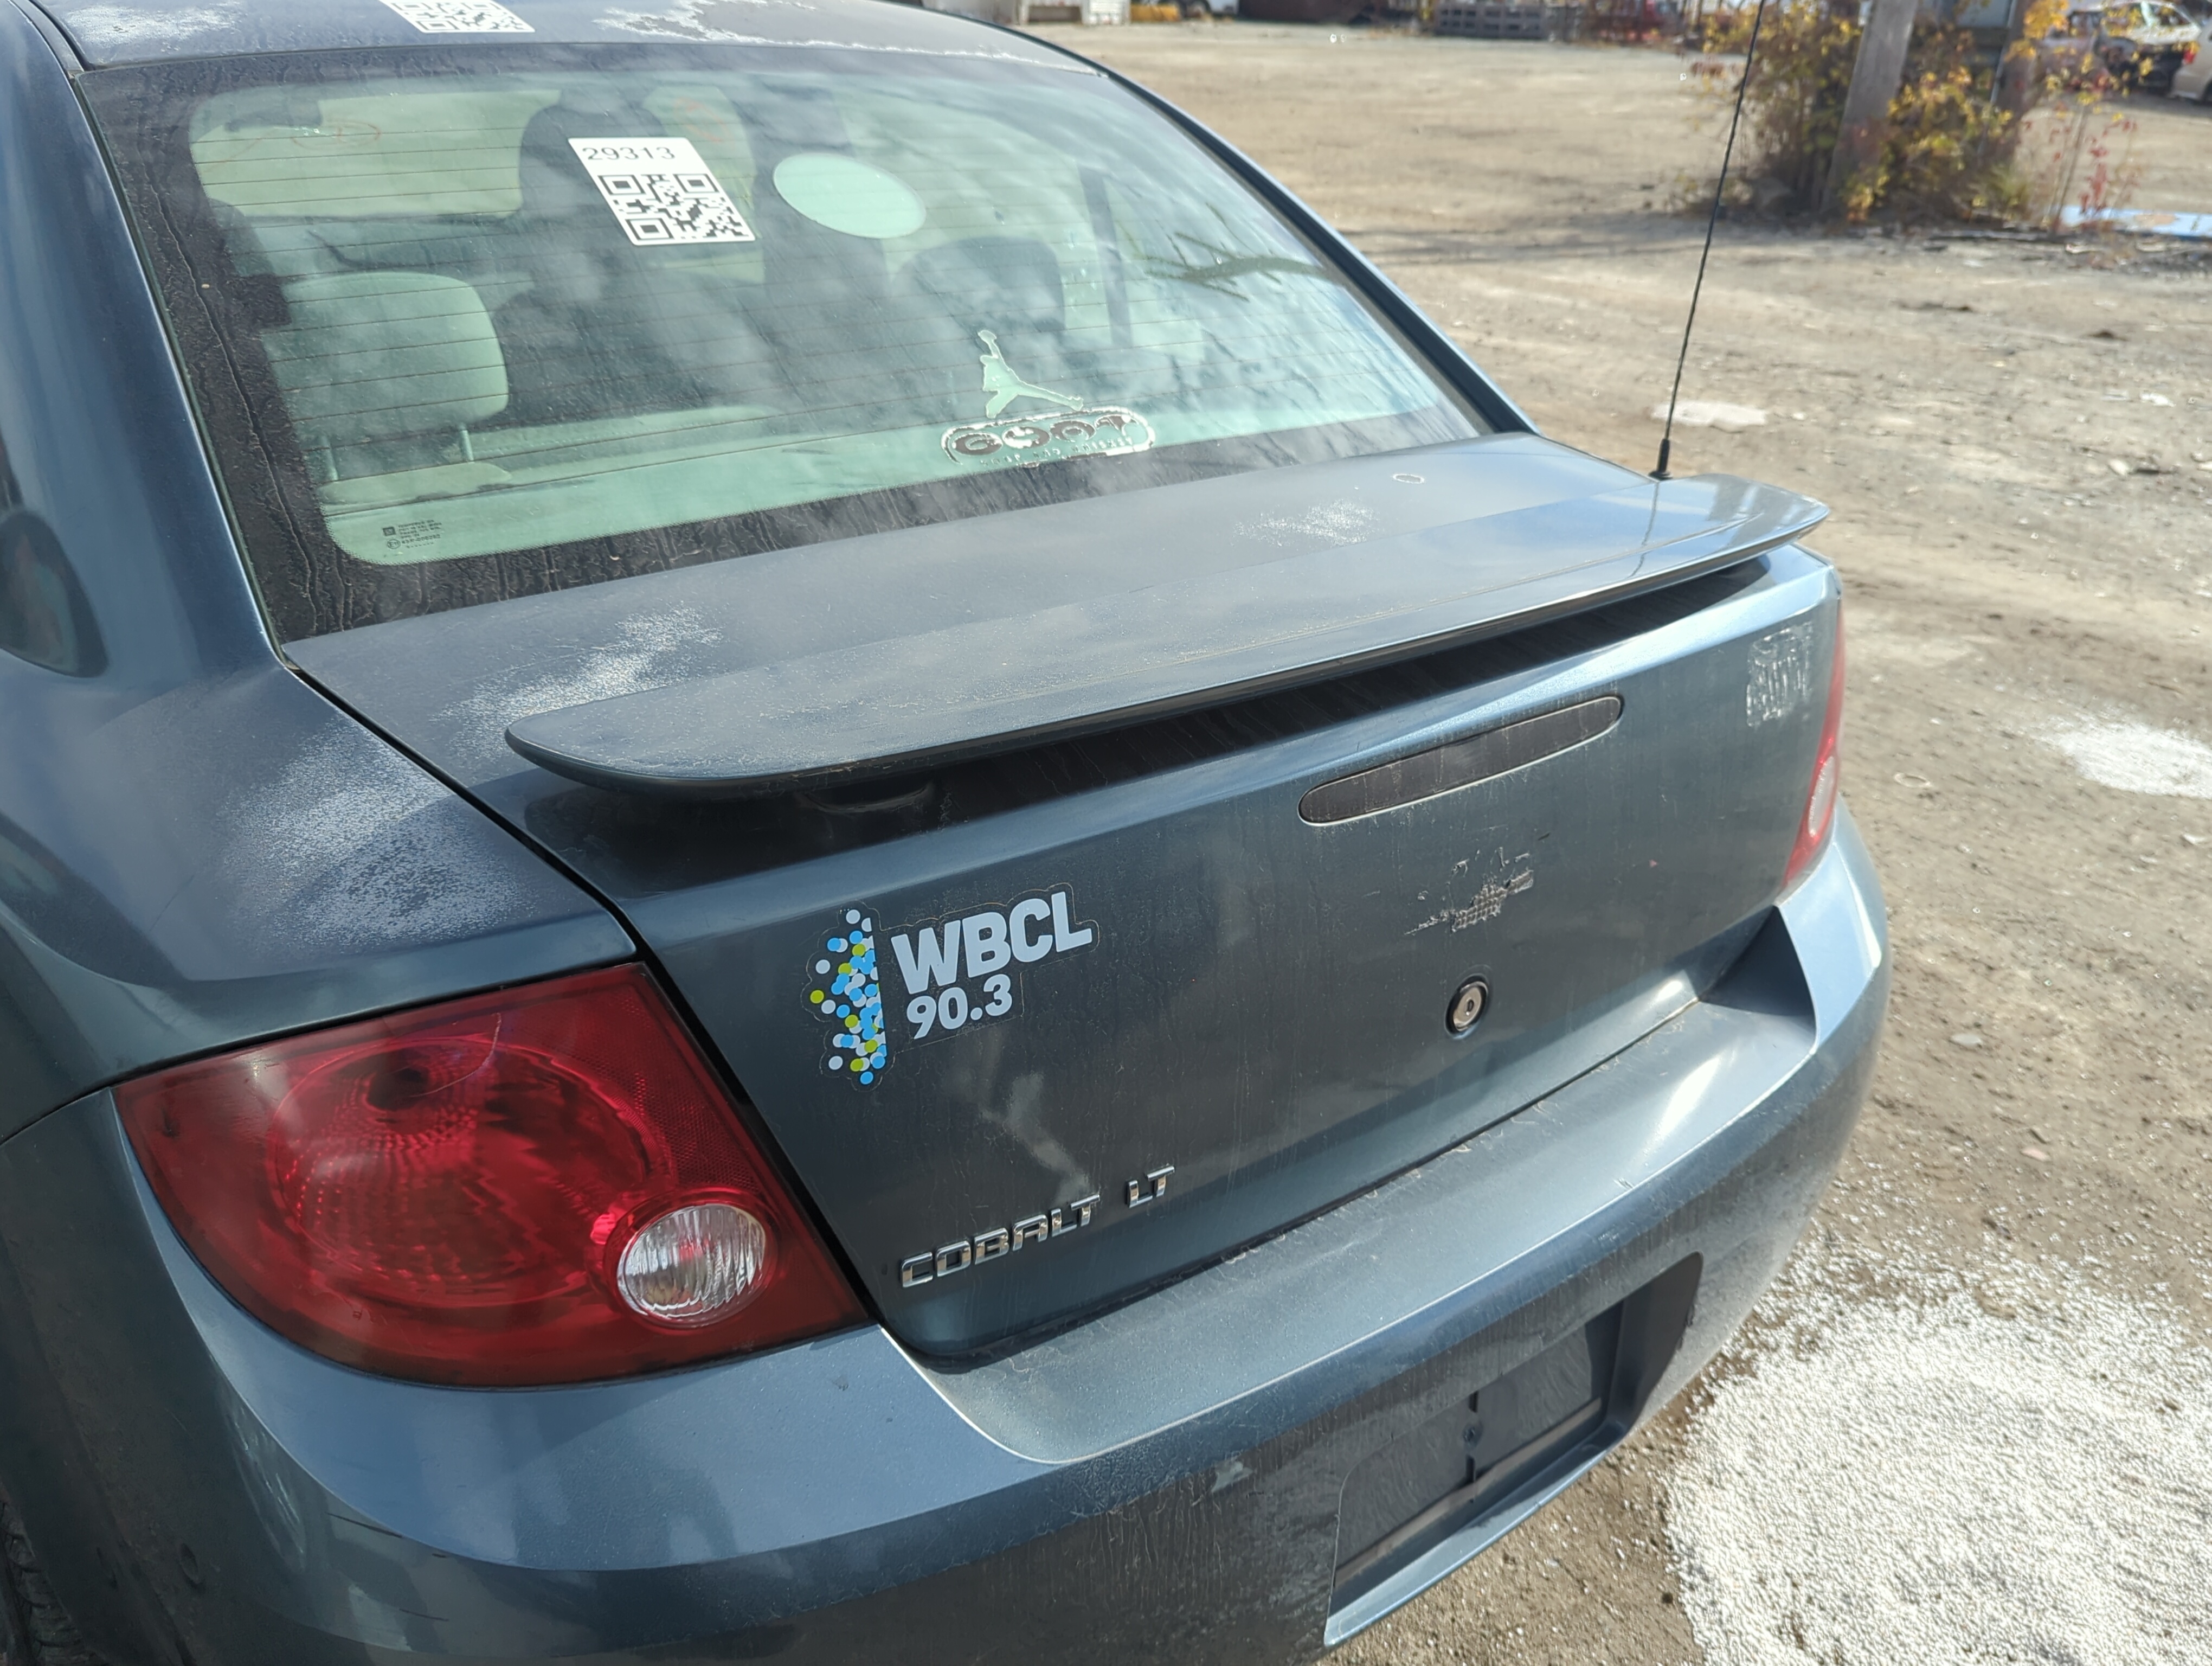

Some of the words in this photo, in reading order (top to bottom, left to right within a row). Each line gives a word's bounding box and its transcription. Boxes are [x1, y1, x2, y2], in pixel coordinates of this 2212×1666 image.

[582, 146, 676, 161] 29313
[890, 891, 1093, 995] WBCL
[906, 974, 1013, 1040] 90.3
[900, 1194, 1101, 1289] COBALT
[1126, 1165, 1176, 1209] LT
